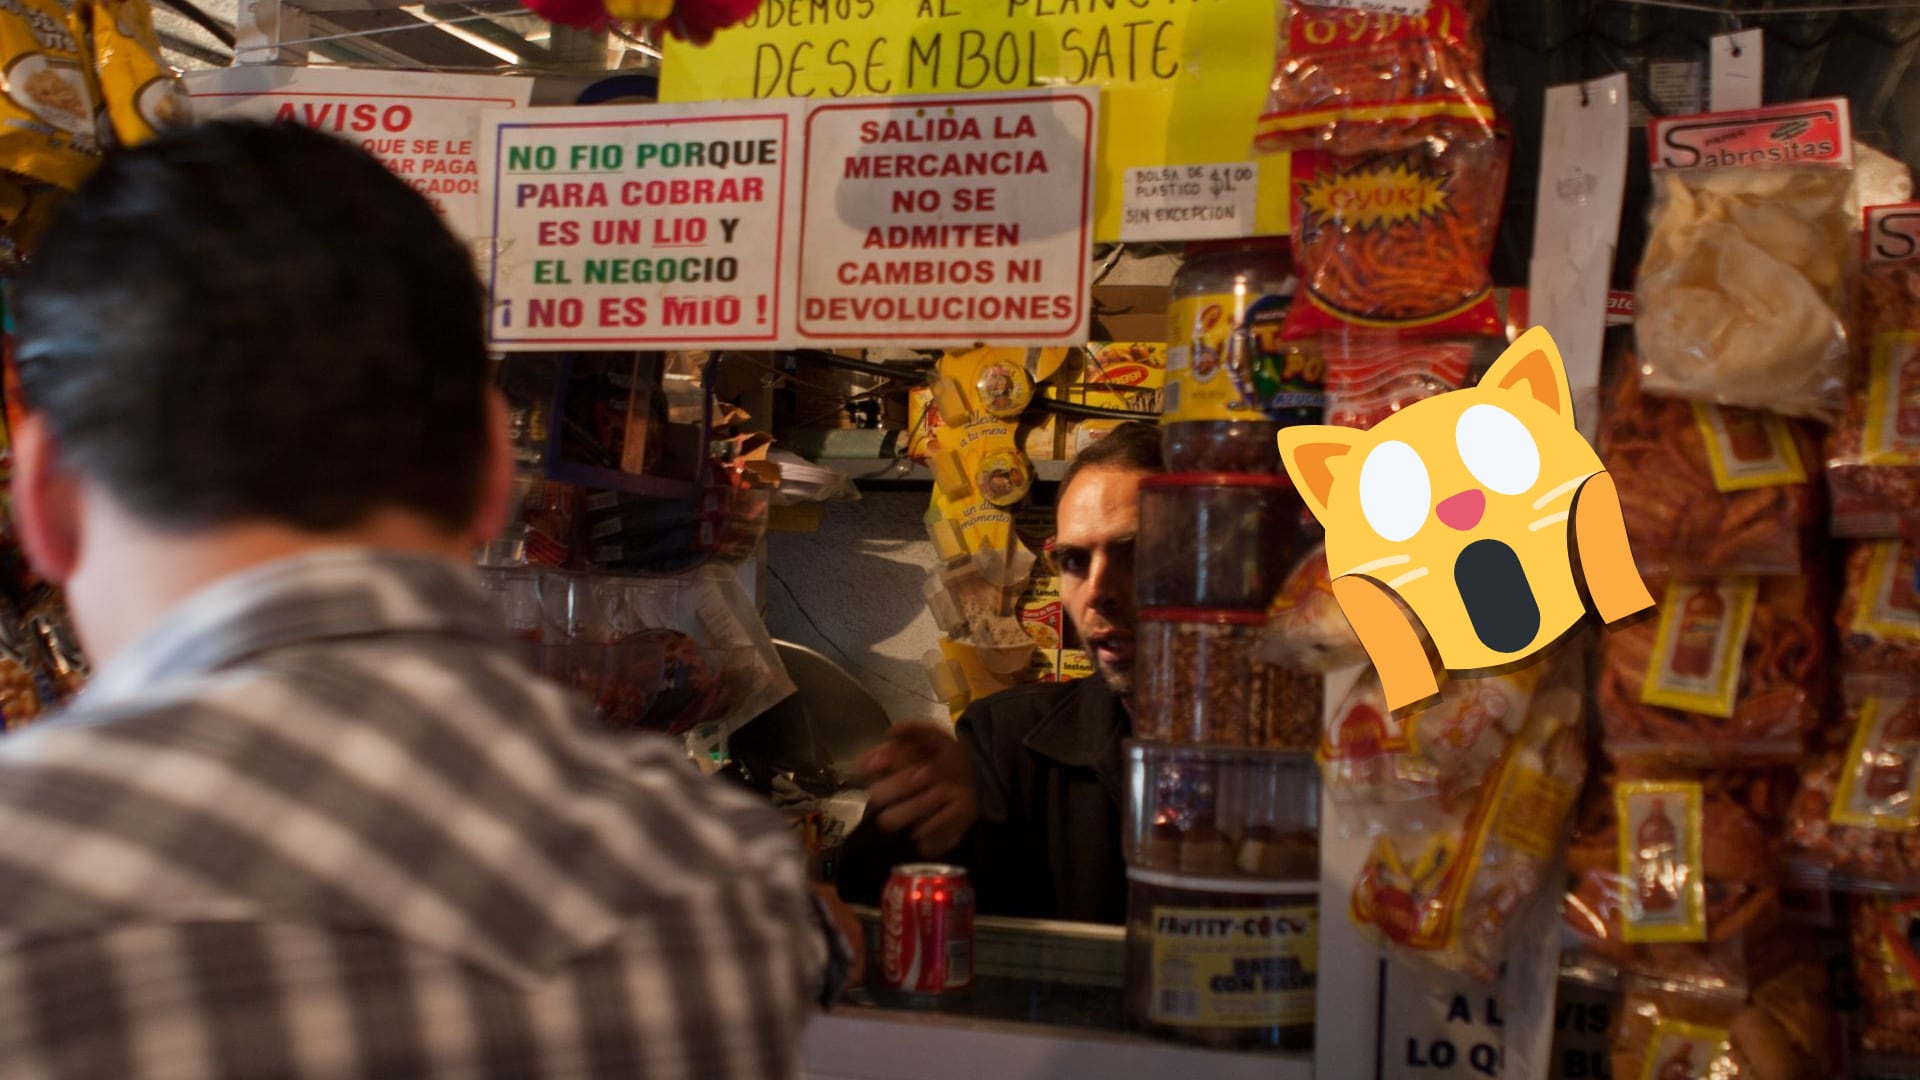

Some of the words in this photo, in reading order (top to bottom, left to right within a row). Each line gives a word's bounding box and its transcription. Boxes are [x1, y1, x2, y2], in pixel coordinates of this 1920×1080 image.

[754, 20, 1179, 98] DESEMBOLSATE
[273, 102, 413, 132] AVISO
[859, 117, 981, 144] SALIDA
[994, 114, 1036, 139] LA
[361, 138, 405, 154] QUE
[411, 140, 439, 154] SE
[445, 140, 472, 155] LE
[1664, 110, 1833, 168] Sabrositas
[378, 158, 414, 174] TAR
[508, 146, 556, 170] NO
[570, 145, 623, 170] FIO
[637, 140, 777, 169] PORQUE
[844, 150, 1048, 179] MERCANCIA
[1136, 168, 1179, 184] BOLSA
[1187, 166, 1203, 178] DE
[517, 182, 608, 208] PARA
[621, 177, 763, 206] COBRAR
[892, 190, 940, 213] NO
[952, 188, 996, 212] SE
[1136, 183, 1201, 197] PLASTICO
[1126, 208, 1150, 224] SIN
[1155, 205, 1235, 222] EXCEPCION
[538, 221, 580, 246] ES
[593, 220, 640, 245] UN
[654, 217, 707, 244] LIO
[719, 218, 739, 243] Y
[862, 223, 1019, 249] ADMITEN
[534, 261, 571, 284] EL
[584, 258, 738, 284] NEGOCIO
[837, 260, 994, 285] CAMBIOS
[1007, 259, 1041, 283] NI
[527, 298, 583, 328] NO
[598, 298, 646, 327] ES
[805, 295, 1072, 321] DEVOLUCIONES
[1447, 994, 1472, 1024] A
[1486, 996, 1504, 1025] L
[1408, 1038, 1455, 1068] LO
